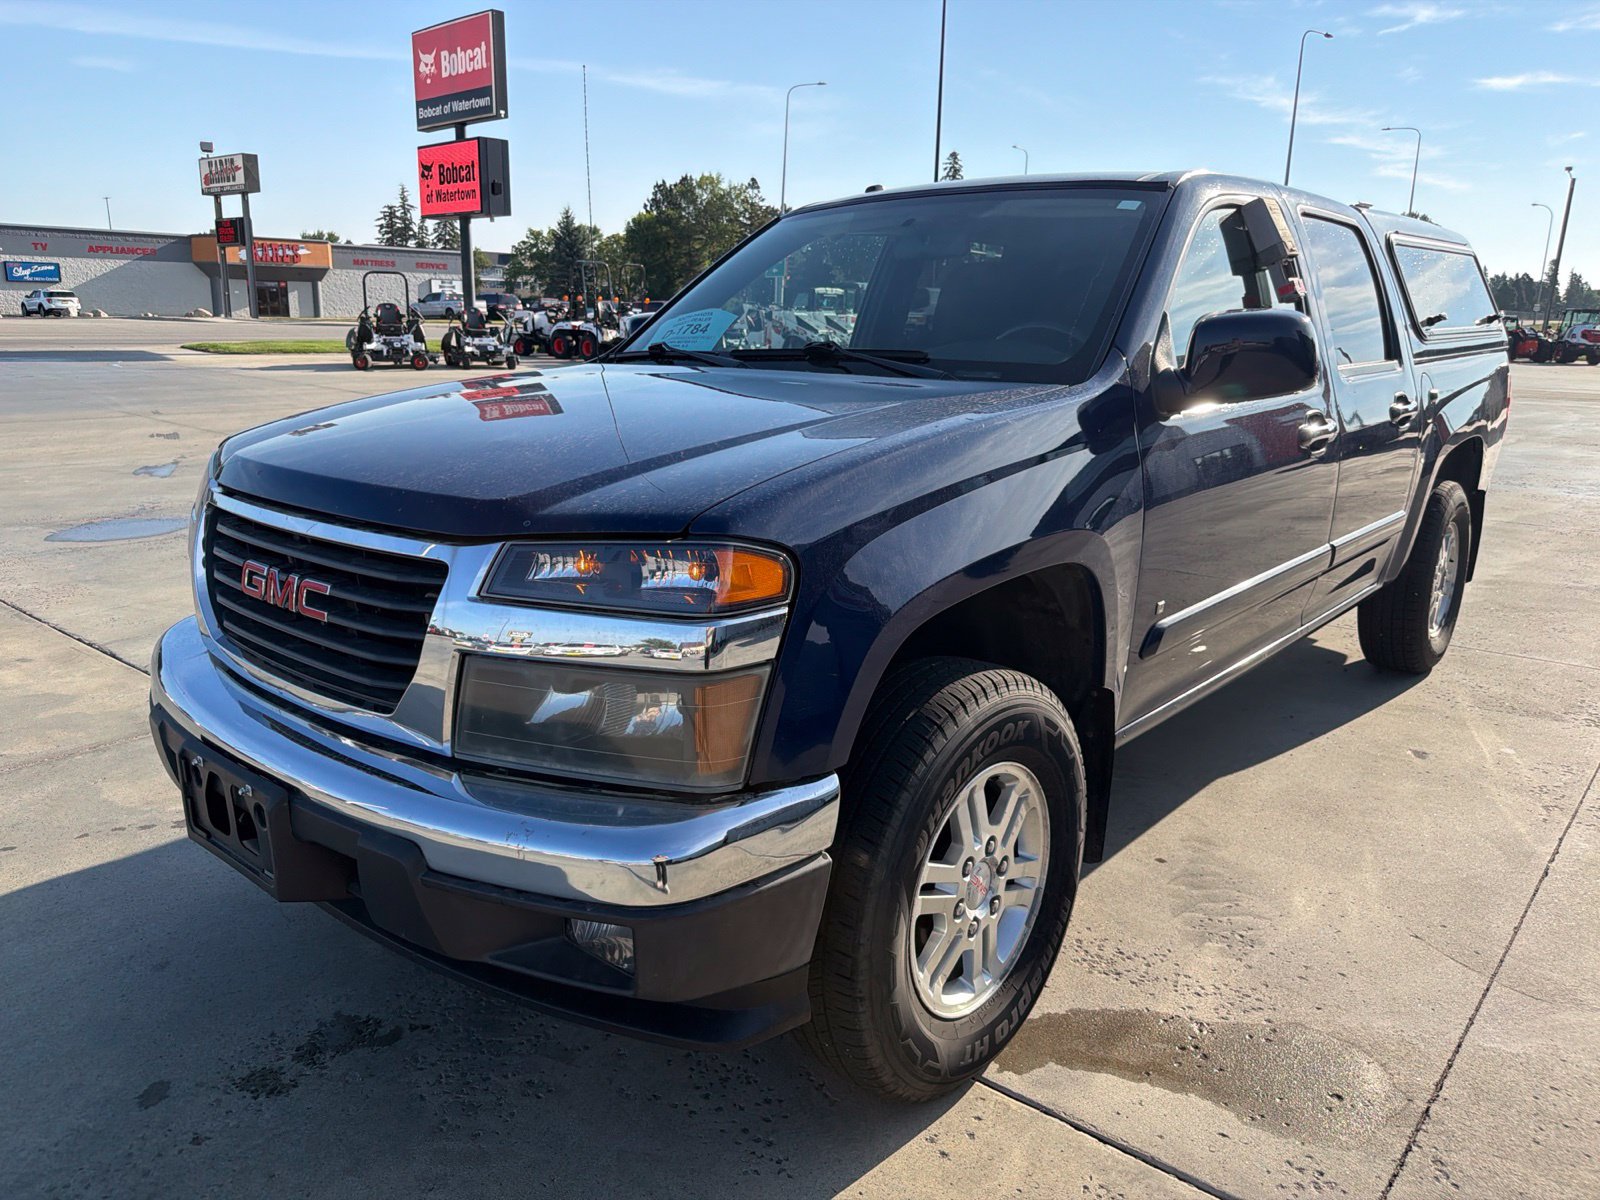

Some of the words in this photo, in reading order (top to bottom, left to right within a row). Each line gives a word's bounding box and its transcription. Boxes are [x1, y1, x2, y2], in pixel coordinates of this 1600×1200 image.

[440, 41, 487, 78] Bobcat
[418, 103, 443, 119] Bobcat
[443, 102, 451, 114] of
[451, 96, 491, 113] Watertown
[438, 160, 476, 185] Bobcat
[426, 191, 434, 204] of
[435, 188, 477, 203] Watertown
[31, 242, 48, 251] TV
[87, 245, 158, 256] APPLIANCES
[252, 241, 302, 263] KARL'S
[352, 258, 396, 268] MATTRESS
[415, 261, 449, 270] SERVICE
[241, 560, 332, 623] GMC
[959, 1034, 990, 1066] HT
